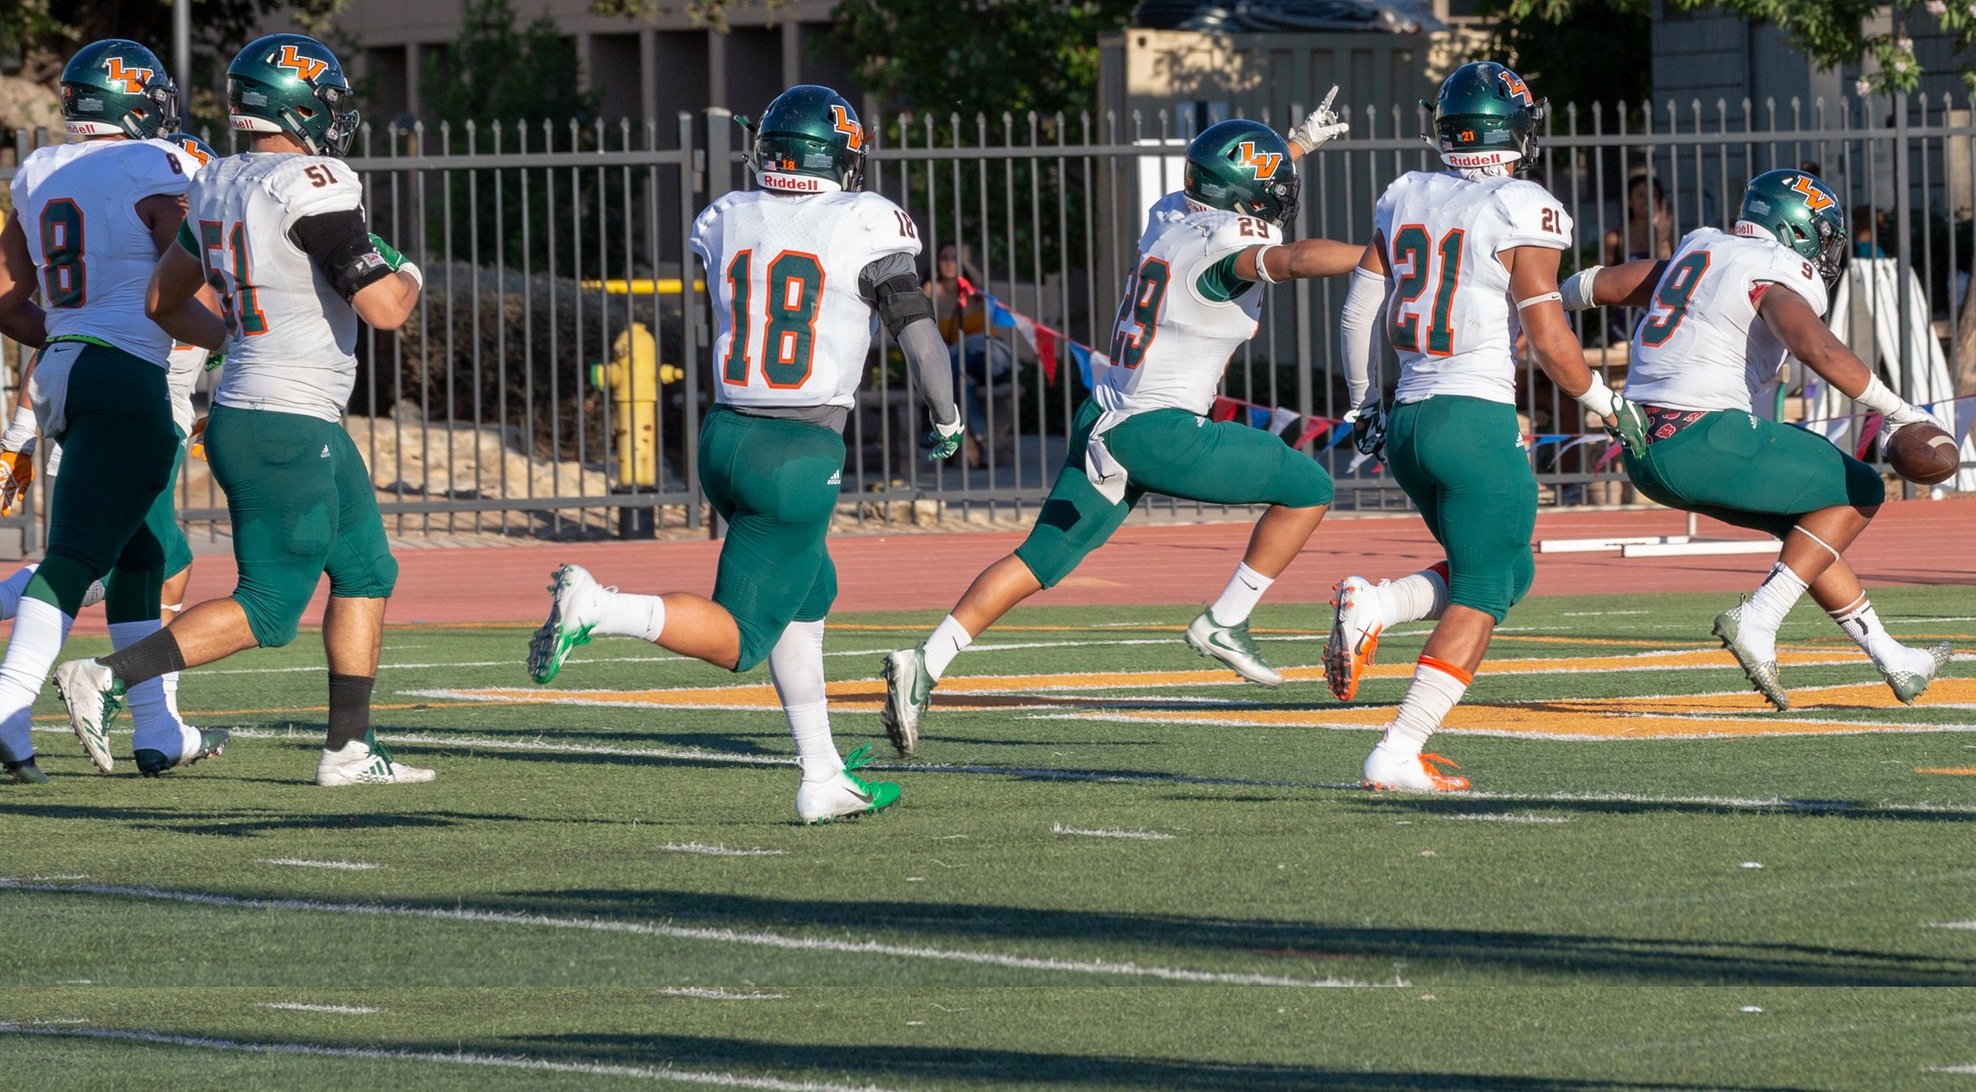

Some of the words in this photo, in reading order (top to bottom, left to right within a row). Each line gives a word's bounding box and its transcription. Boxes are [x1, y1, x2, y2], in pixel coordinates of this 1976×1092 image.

[106, 57, 154, 95] LV
[277, 45, 328, 82] LV
[830, 104, 864, 152] LV
[1462, 130, 1475, 141] 21
[166, 152, 183, 175] 8
[303, 163, 338, 188] 51
[782, 160, 796, 170] 18
[1237, 141, 1283, 180] LV
[1449, 153, 1501, 166] Riddell
[764, 175, 818, 190] Riddell
[1791, 175, 1836, 212] LV
[893, 209, 916, 240] 18
[1237, 217, 1270, 239] 29
[1541, 207, 1562, 235] 21
[39, 197, 87, 309] 8
[1801, 262, 1814, 280] 9
[199, 220, 270, 337] 51
[1387, 223, 1465, 357] 21
[1109, 249, 1171, 370] 29
[1641, 250, 1711, 349] 9
[723, 248, 826, 390] 18
